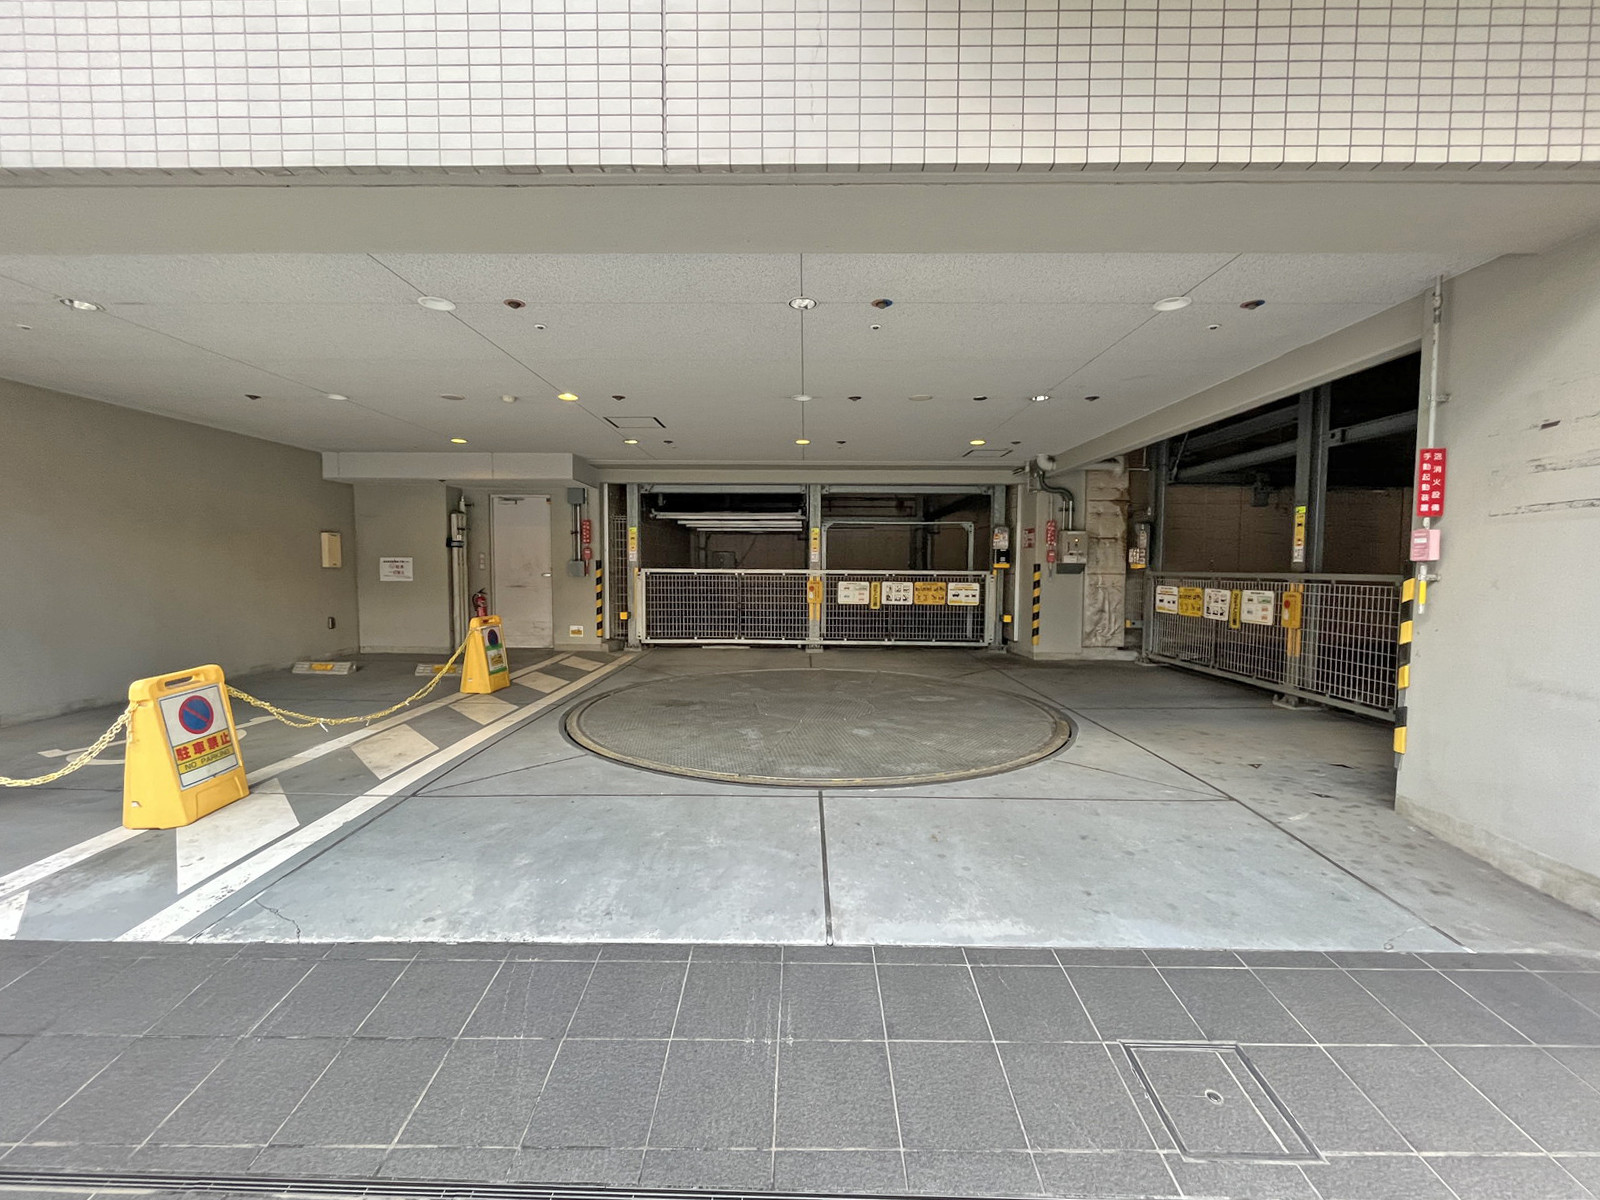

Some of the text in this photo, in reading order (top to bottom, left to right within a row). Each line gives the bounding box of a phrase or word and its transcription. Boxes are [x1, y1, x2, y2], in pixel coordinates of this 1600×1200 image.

[175, 732, 231, 761] 駐車禁止
[184, 749, 230, 771] NO PARKING
